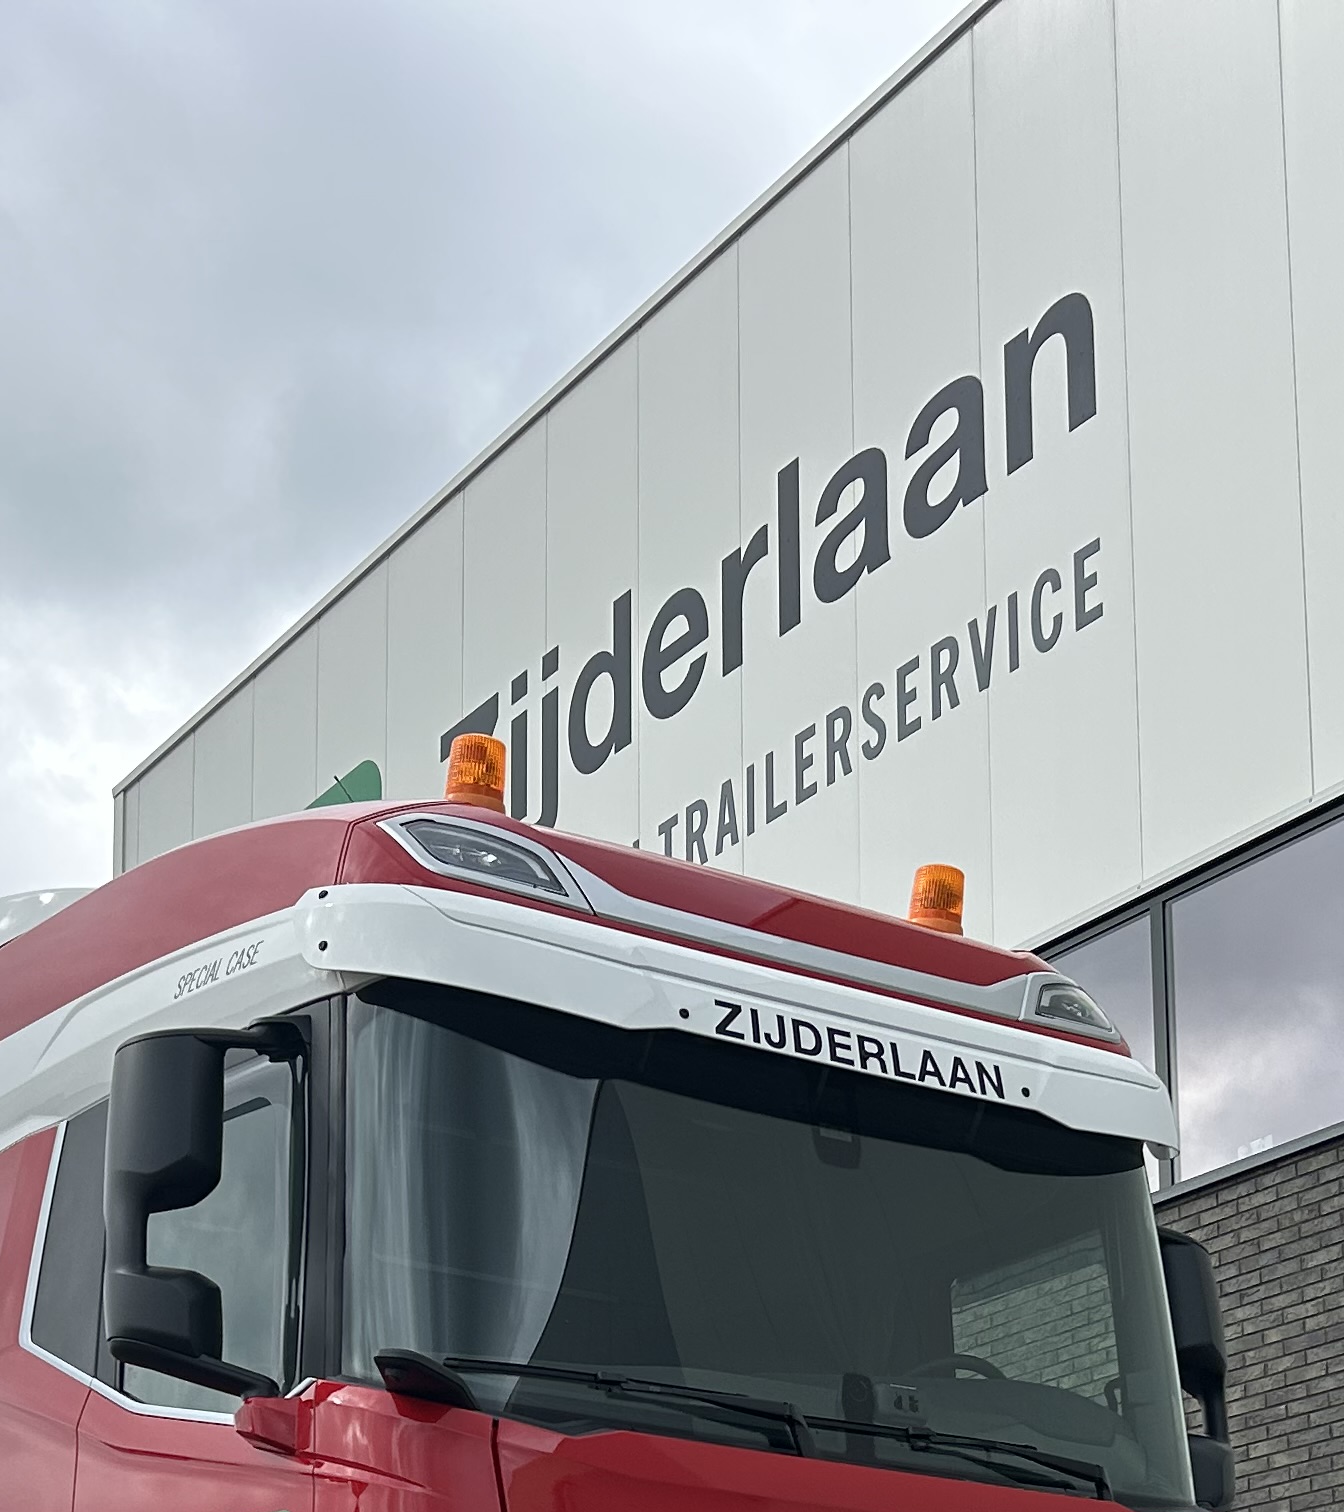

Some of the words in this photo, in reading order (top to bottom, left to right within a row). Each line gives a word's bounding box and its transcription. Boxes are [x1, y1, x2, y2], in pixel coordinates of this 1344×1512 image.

[173, 957, 223, 1000] SPECIAL
[225, 939, 265, 976] CASE
[713, 998, 1006, 1100] ZIJDERLAAN
